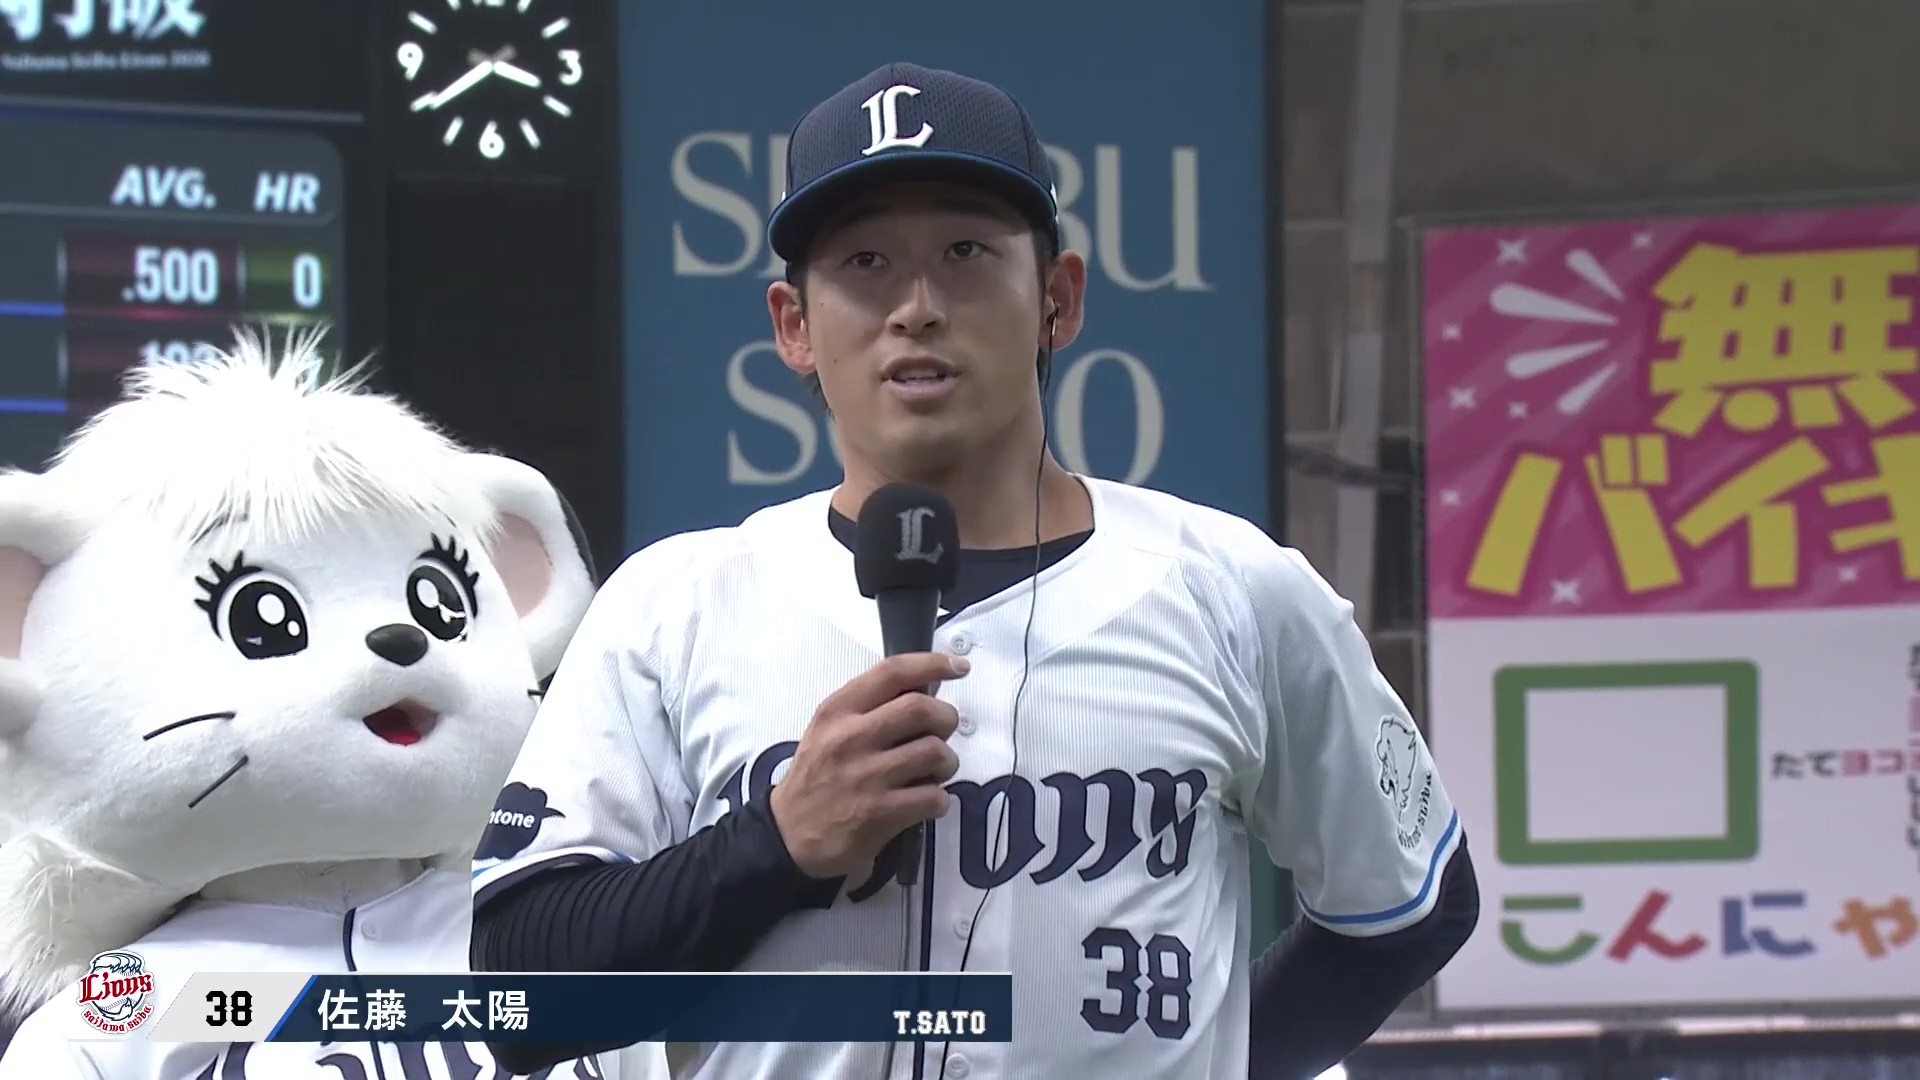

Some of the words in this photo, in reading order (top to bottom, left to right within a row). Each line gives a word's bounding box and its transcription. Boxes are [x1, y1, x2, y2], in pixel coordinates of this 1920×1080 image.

[397, 42, 423, 81] 9
[558, 49, 582, 85] 3
[479, 120, 505, 158] 6
[861, 84, 934, 156] L
[111, 165, 217, 209] AVG.
[253, 171, 320, 213] HR
[121, 246, 218, 303] .500
[293, 254, 322, 307] 0
[1650, 241, 1920, 437] 無
[895, 506, 944, 565] L
[1081, 927, 1192, 1039] 38
